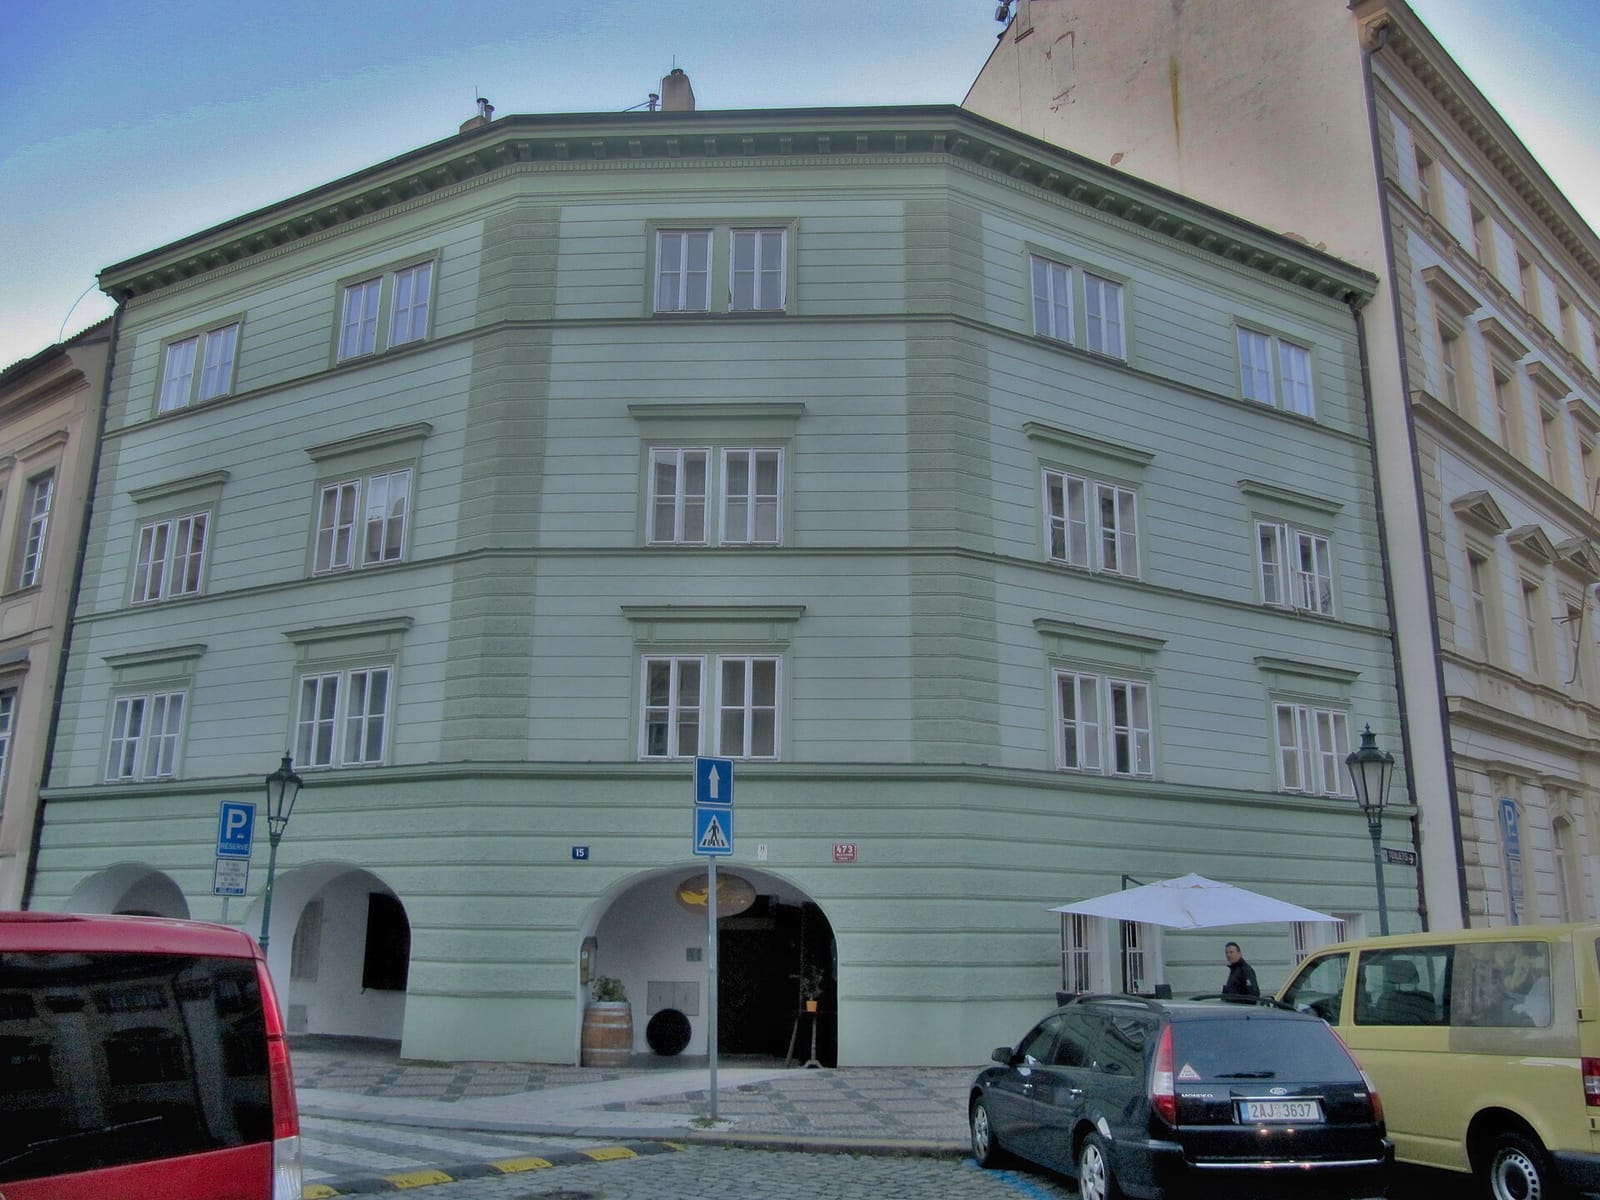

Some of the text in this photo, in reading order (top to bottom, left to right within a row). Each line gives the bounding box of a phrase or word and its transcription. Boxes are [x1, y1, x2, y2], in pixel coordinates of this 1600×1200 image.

[226, 808, 247, 839] P
[1505, 805, 1514, 838] P
[576, 848, 585, 857] 15
[836, 845, 853, 853] 473
[1251, 1103, 1312, 1118] 2AJ 3637
